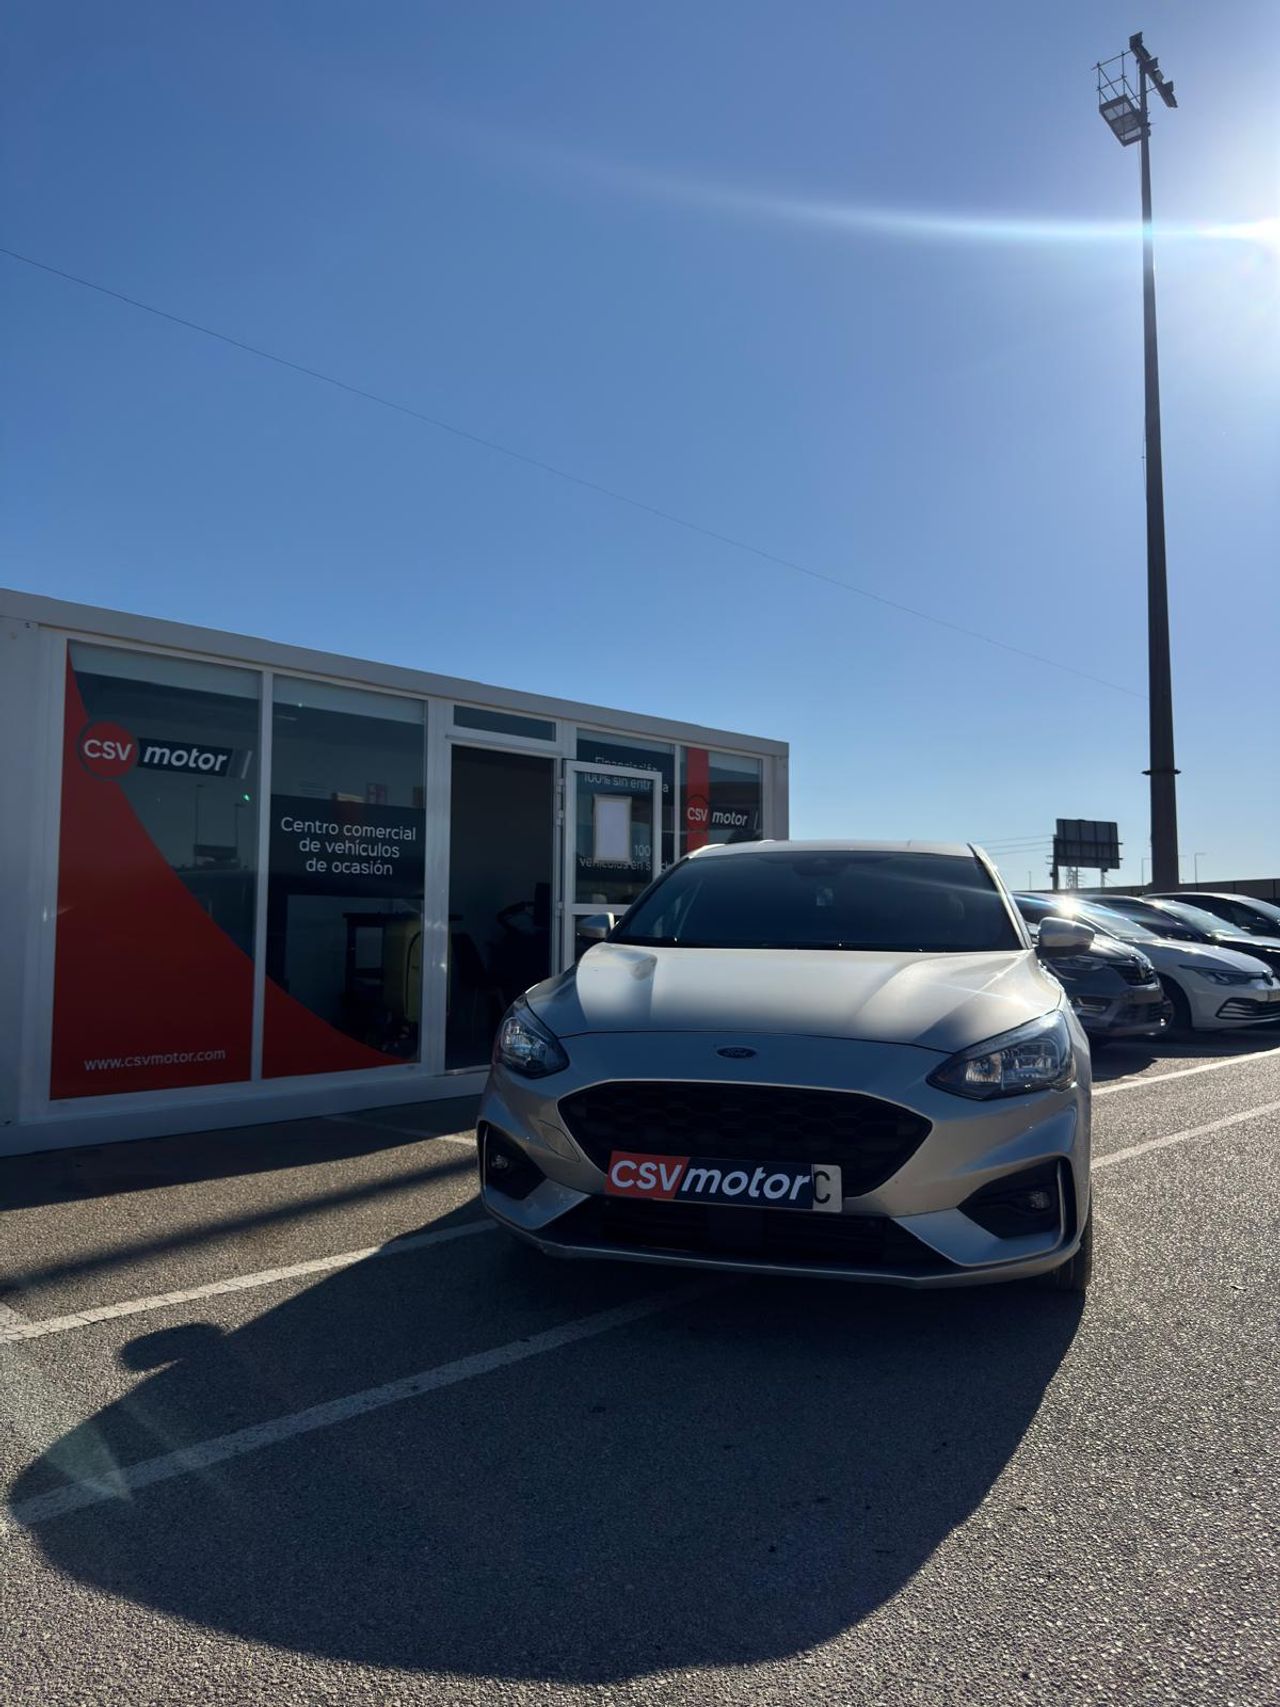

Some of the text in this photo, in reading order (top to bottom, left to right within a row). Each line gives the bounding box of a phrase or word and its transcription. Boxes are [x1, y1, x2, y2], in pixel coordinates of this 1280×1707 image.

[84, 739, 227, 771] CSV motor
[630, 779, 669, 793] entra
[687, 807, 748, 826] CSV motor
[281, 816, 416, 841] Centro comercial
[299, 837, 400, 858] de vehículos
[635, 844, 651, 857] 100
[306, 857, 393, 875] de ocasión
[84, 1049, 227, 1072] www.csvmotor.com
